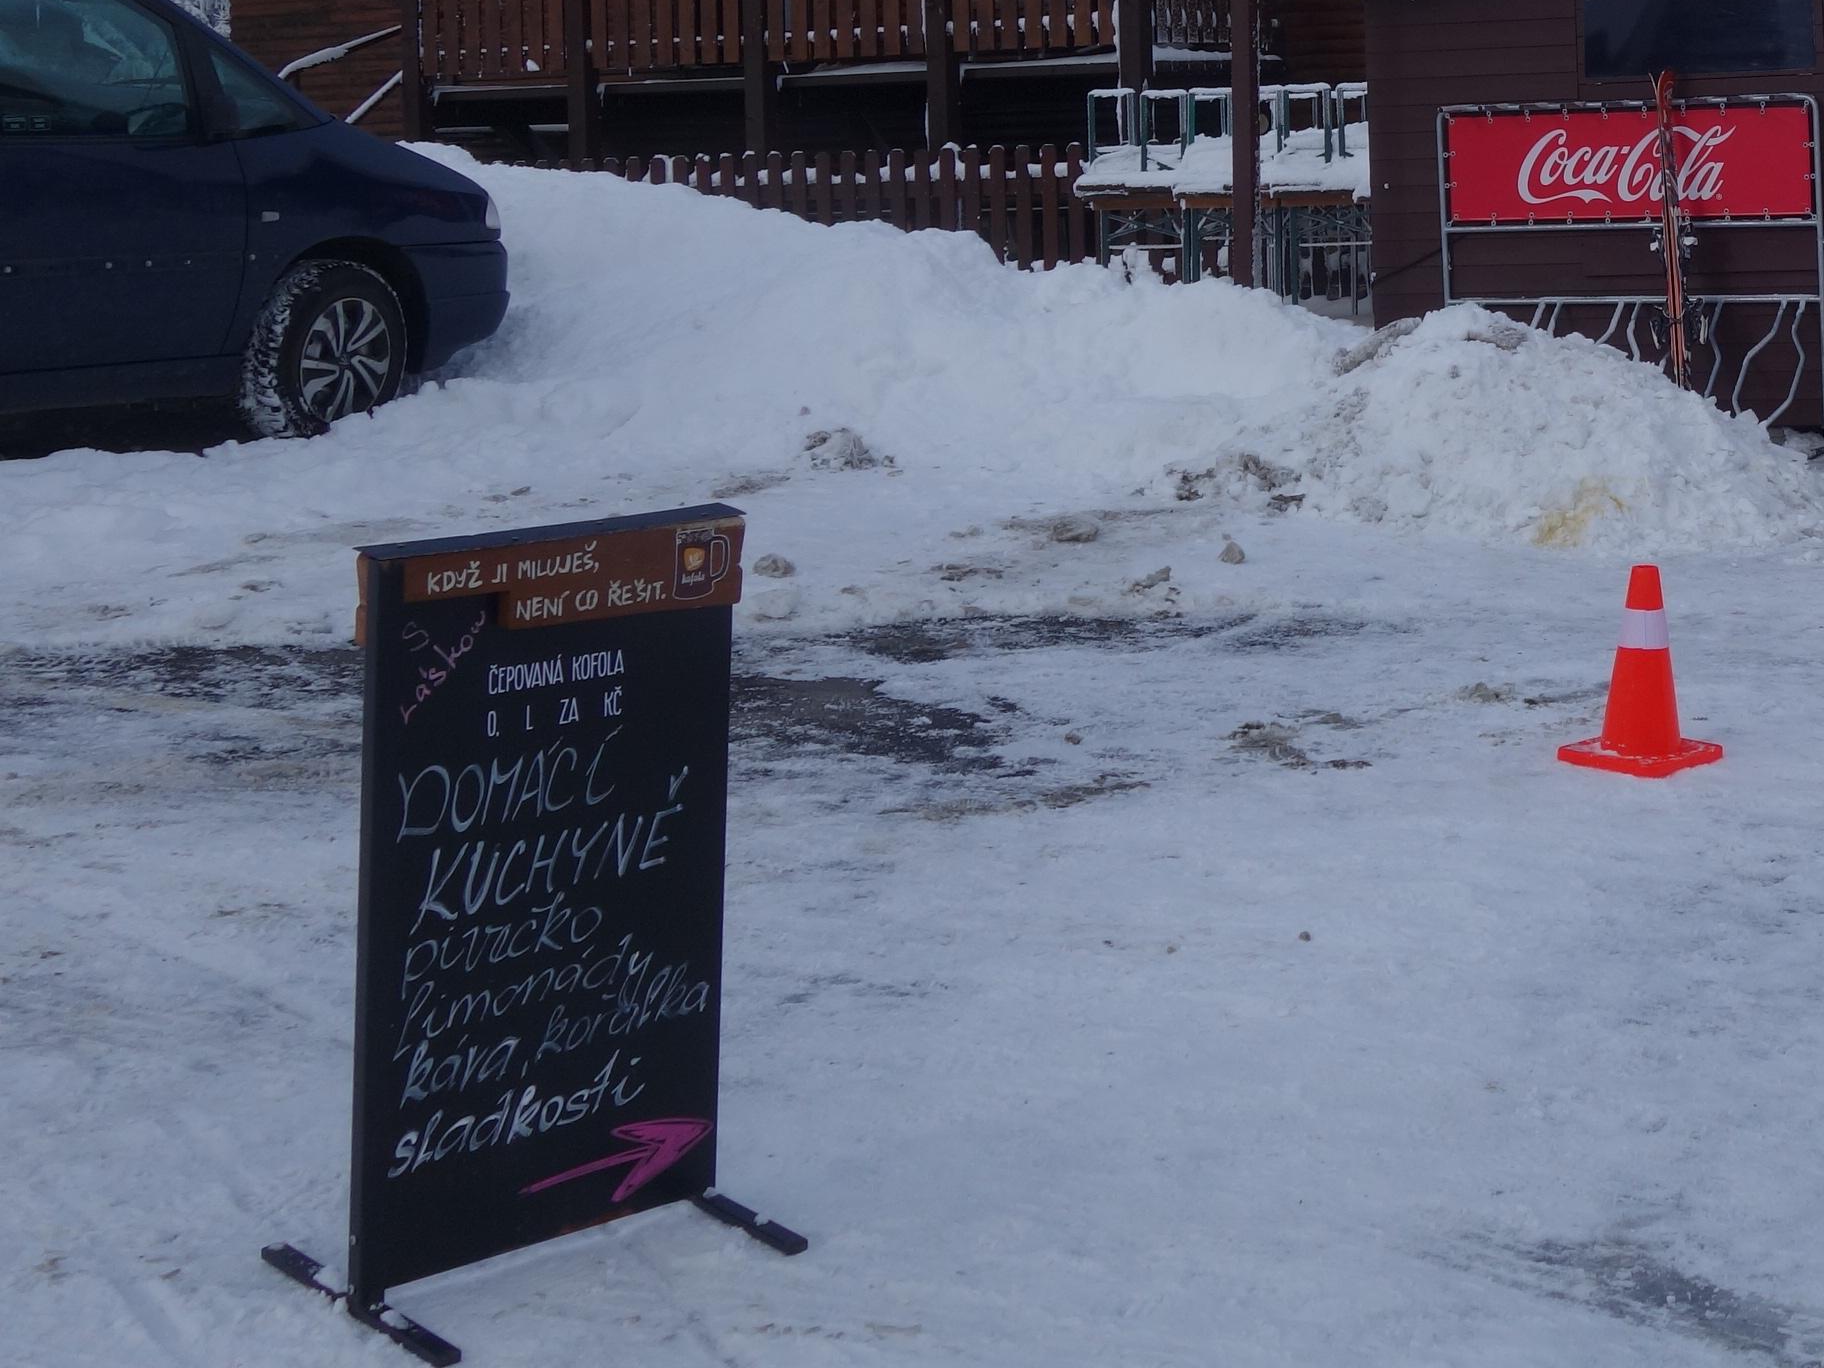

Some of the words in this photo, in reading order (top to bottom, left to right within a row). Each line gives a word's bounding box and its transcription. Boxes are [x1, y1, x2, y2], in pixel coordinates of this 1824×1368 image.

[427, 560, 483, 596] KDYŽ
[491, 563, 508, 584] JI
[517, 540, 600, 580] MILUJEŠ,
[515, 590, 571, 621] NENÍ
[575, 589, 599, 612] CO
[607, 577, 667, 608] ŘEŠIT.
[488, 653, 564, 695] ČEPOVANÁ
[571, 649, 625, 682] KOFOLA
[559, 696, 580, 725] ZA
[603, 685, 623, 717] KČ
[409, 765, 689, 936] KUCHYNĚ
[387, 1048, 646, 1178] sladkosti
